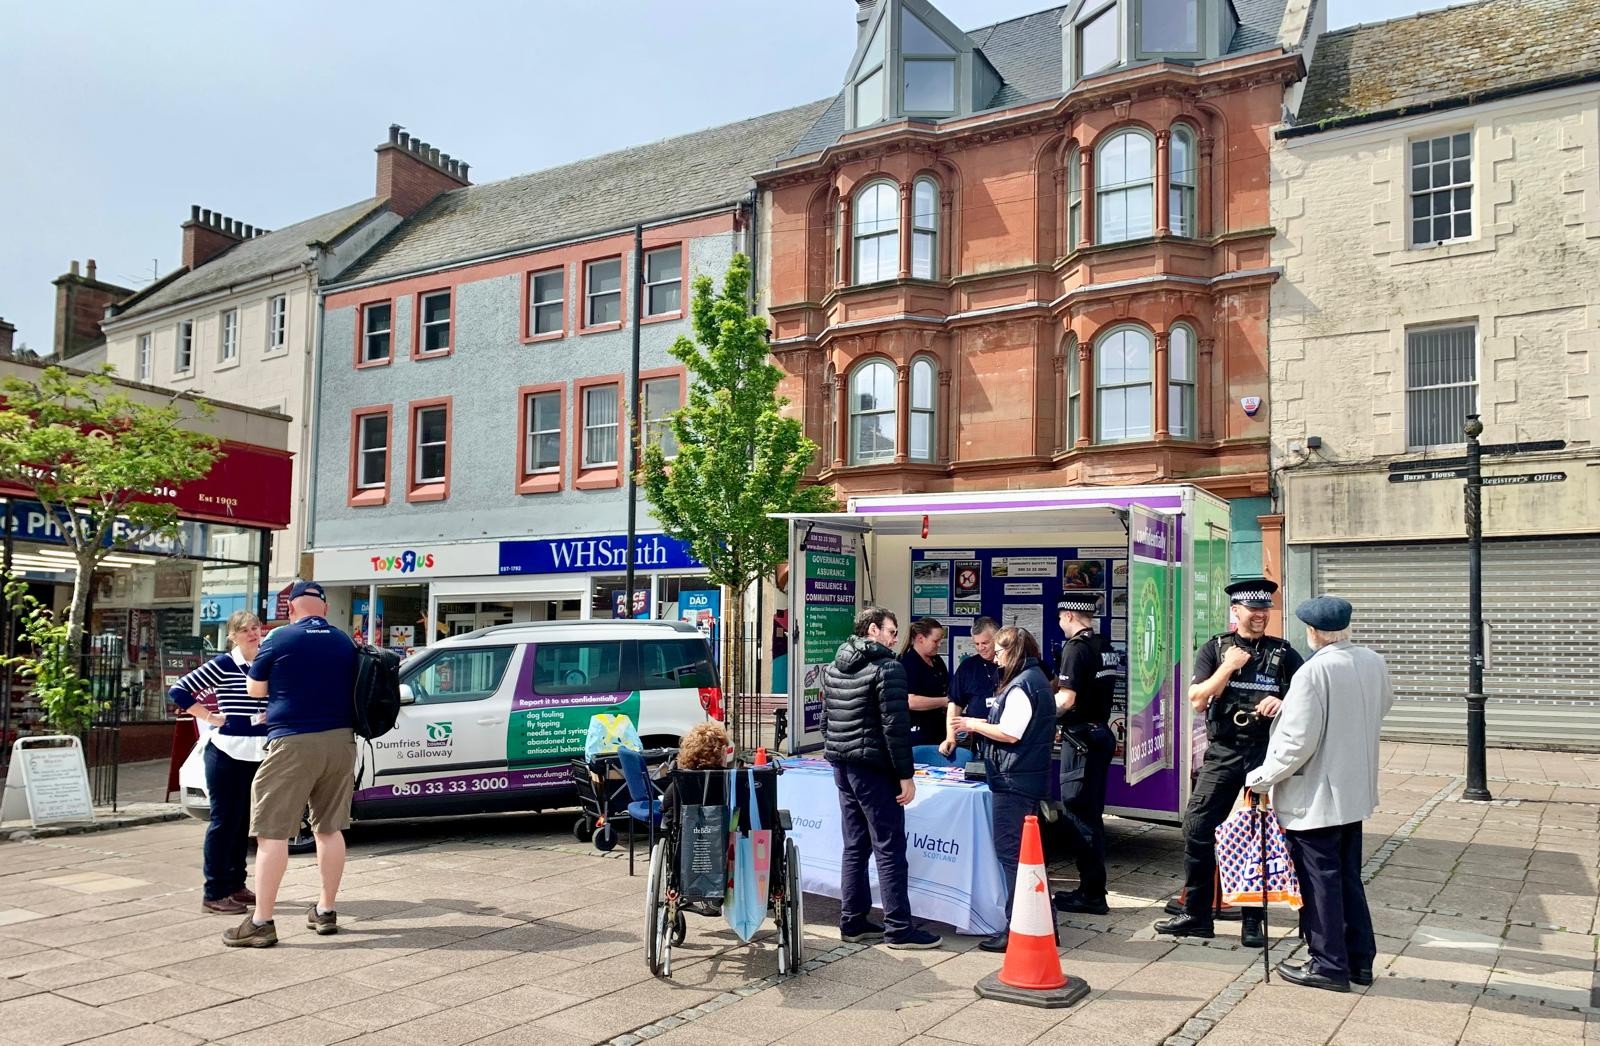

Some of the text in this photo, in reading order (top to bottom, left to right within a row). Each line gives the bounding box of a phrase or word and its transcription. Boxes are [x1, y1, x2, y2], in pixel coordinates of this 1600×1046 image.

[1403, 471, 1456, 481] Burns House
[1482, 473, 1563, 485] Registrar's Office
[198, 494, 238, 506] Est 1903
[27, 511, 102, 541] Phot
[1136, 526, 1166, 554] confidentially
[549, 537, 668, 568] WHSmith
[812, 555, 845, 565] GOVERNANCE
[817, 568, 846, 577] ASSURANCE
[814, 581, 848, 591] RESILIENCE &
[616, 591, 646, 604] PCE
[689, 596, 708, 605] DAD
[806, 593, 855, 603] COMMUNITY SAFETY
[617, 601, 645, 613] DOP
[955, 607, 978, 615] FOUL
[1255, 674, 1275, 683] POLICE
[519, 698, 544, 707] Report
[571, 694, 618, 704] confidentially
[526, 711, 564, 720] dog fouling
[537, 720, 560, 728] tipping
[527, 729, 552, 737] needles
[376, 739, 421, 750] Dumfries
[527, 737, 565, 746] abandoned
[396, 749, 453, 759] & Galloway
[527, 745, 586, 755] antisocial behavio
[425, 782, 443, 794] 33
[448, 780, 467, 792] 33
[471, 777, 509, 790] 3000
[913, 832, 959, 855] Watch
[922, 851, 957, 863] SCOTLAND
